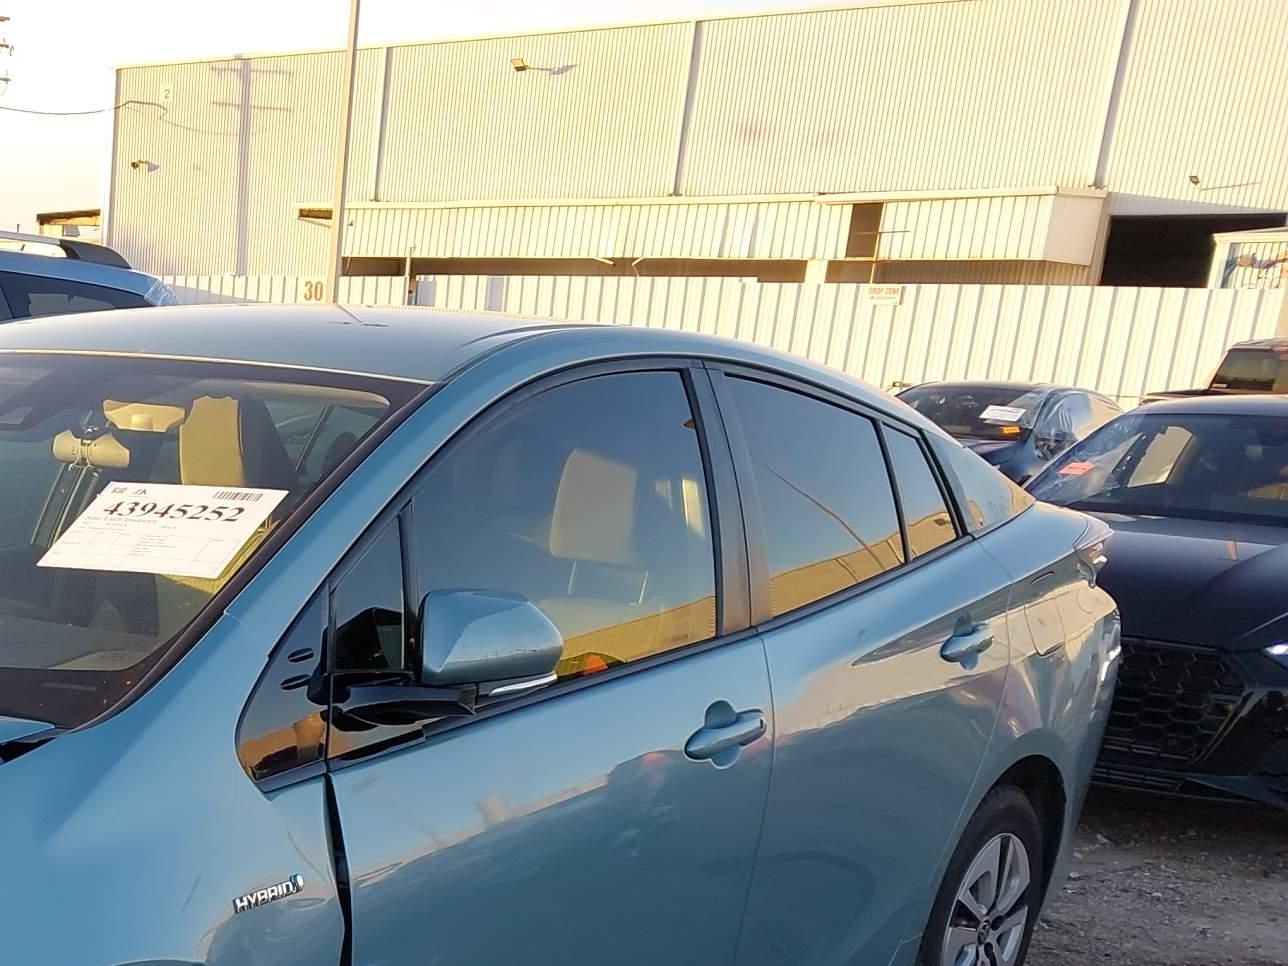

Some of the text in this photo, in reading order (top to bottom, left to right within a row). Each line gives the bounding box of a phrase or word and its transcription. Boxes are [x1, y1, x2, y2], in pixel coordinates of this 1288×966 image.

[304, 280, 324, 302] 30
[103, 500, 246, 522] 43945252
[233, 880, 297, 913] HYBRID
